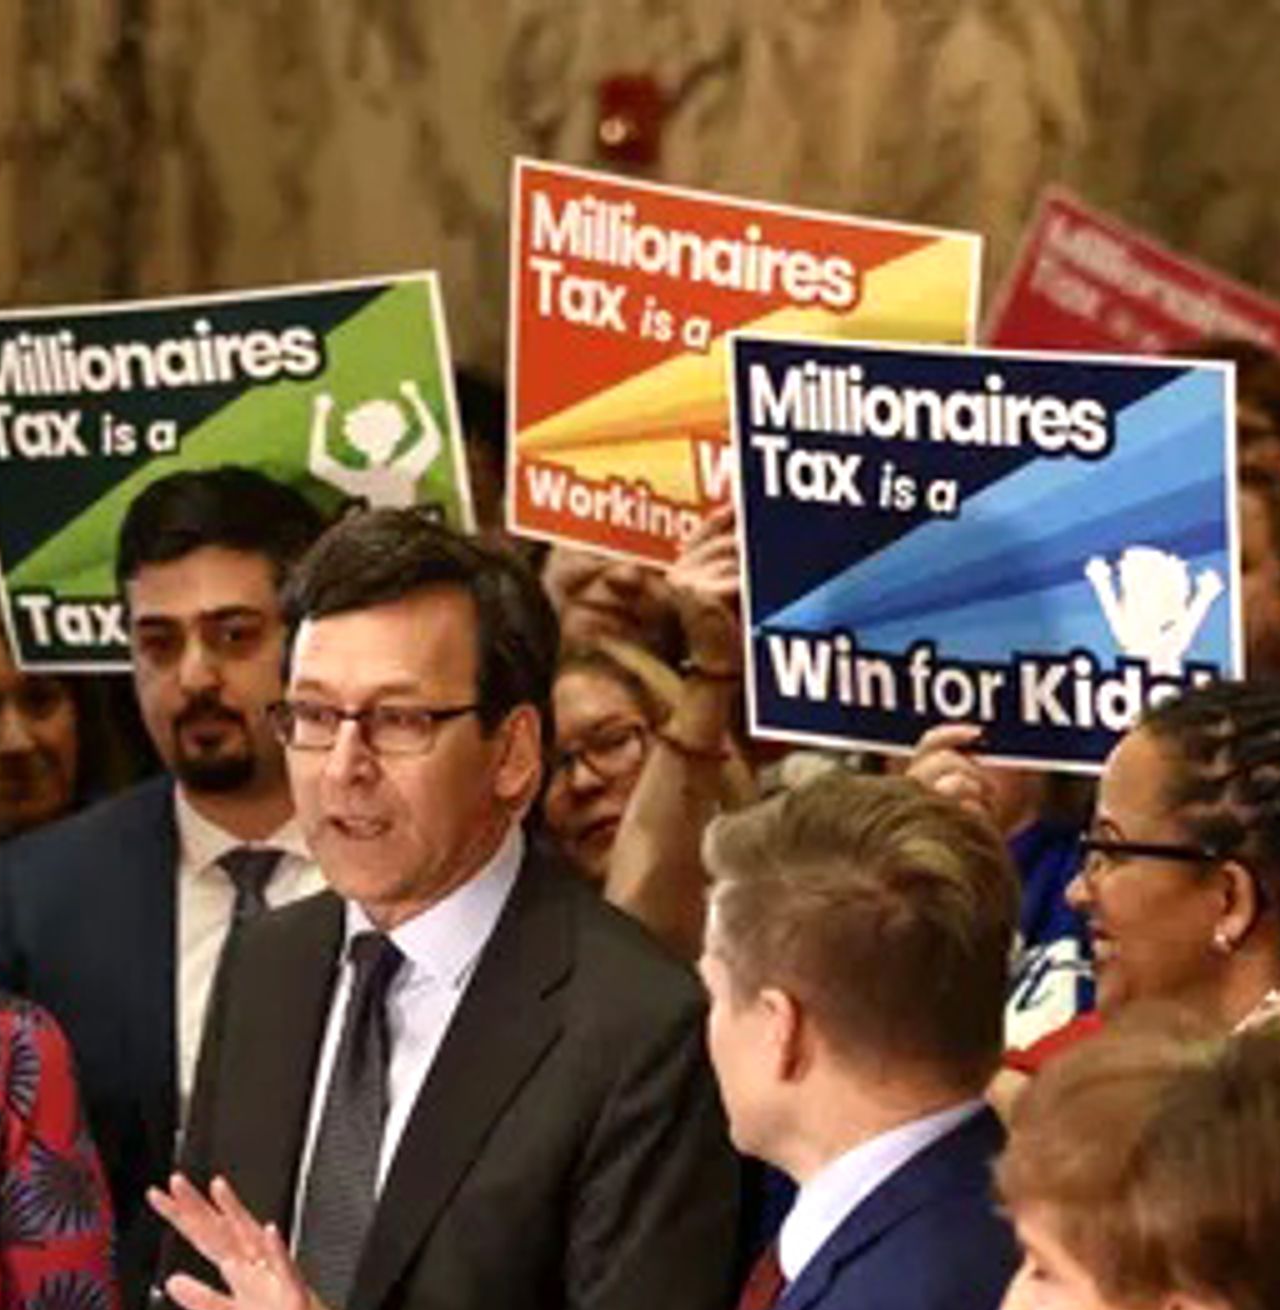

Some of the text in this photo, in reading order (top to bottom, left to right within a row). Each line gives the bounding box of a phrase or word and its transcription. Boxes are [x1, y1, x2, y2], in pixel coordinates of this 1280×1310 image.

[530, 190, 855, 306] Millionaires
[528, 256, 711, 350] Tax is a
[101, 415, 137, 456] is
[146, 418, 178, 454] a
[748, 360, 1109, 454] Millionaires
[749, 435, 864, 506] Tax
[879, 462, 916, 509] is
[926, 480, 959, 514] a
[19, 595, 130, 647] Tax
[767, 634, 898, 710] Win
[908, 643, 1004, 722] for
